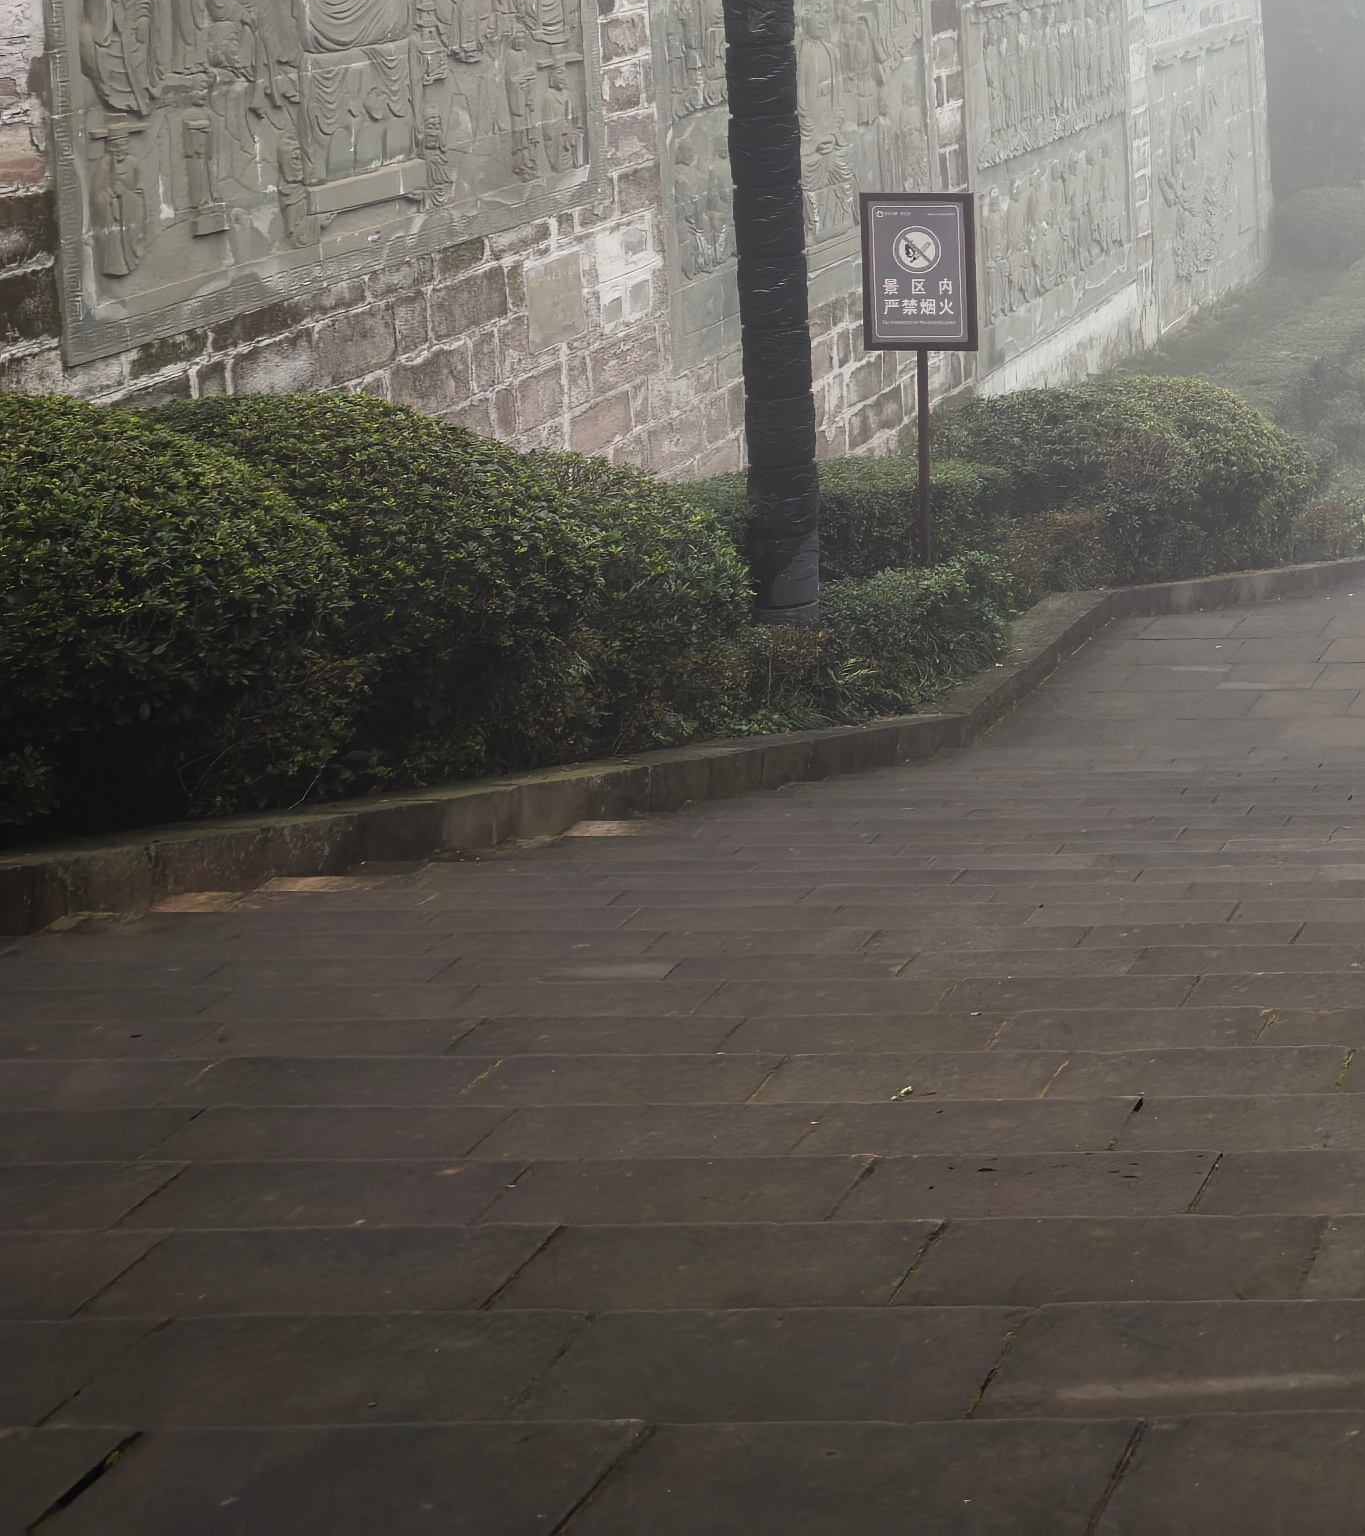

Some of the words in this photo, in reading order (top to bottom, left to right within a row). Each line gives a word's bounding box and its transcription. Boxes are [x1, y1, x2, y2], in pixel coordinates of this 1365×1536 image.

[882, 278, 953, 295] 景区内
[883, 298, 954, 315] 严禁烟火
